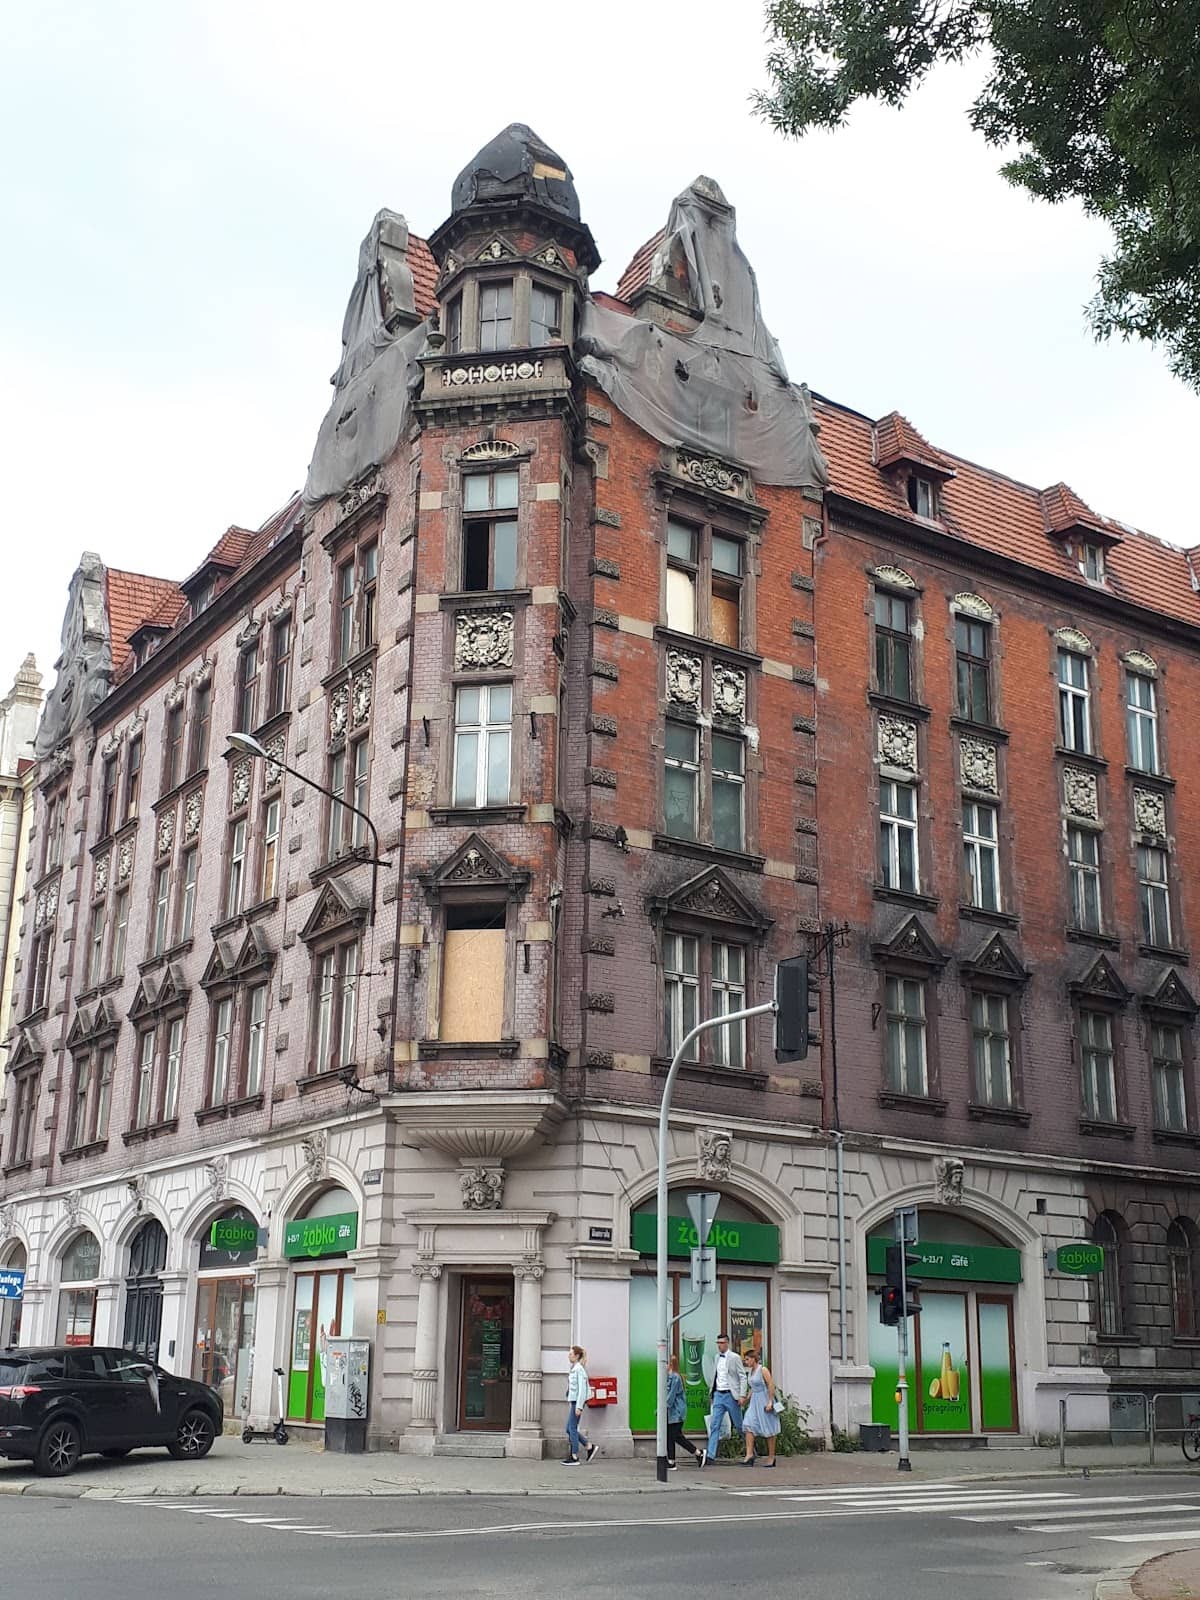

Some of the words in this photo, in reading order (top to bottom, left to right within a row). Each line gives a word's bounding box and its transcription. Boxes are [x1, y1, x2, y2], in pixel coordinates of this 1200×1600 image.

[219, 1225, 256, 1241] żabka
[303, 1224, 336, 1247] żabka
[950, 1255, 969, 1267] café
[1060, 1250, 1098, 1264] żabka
